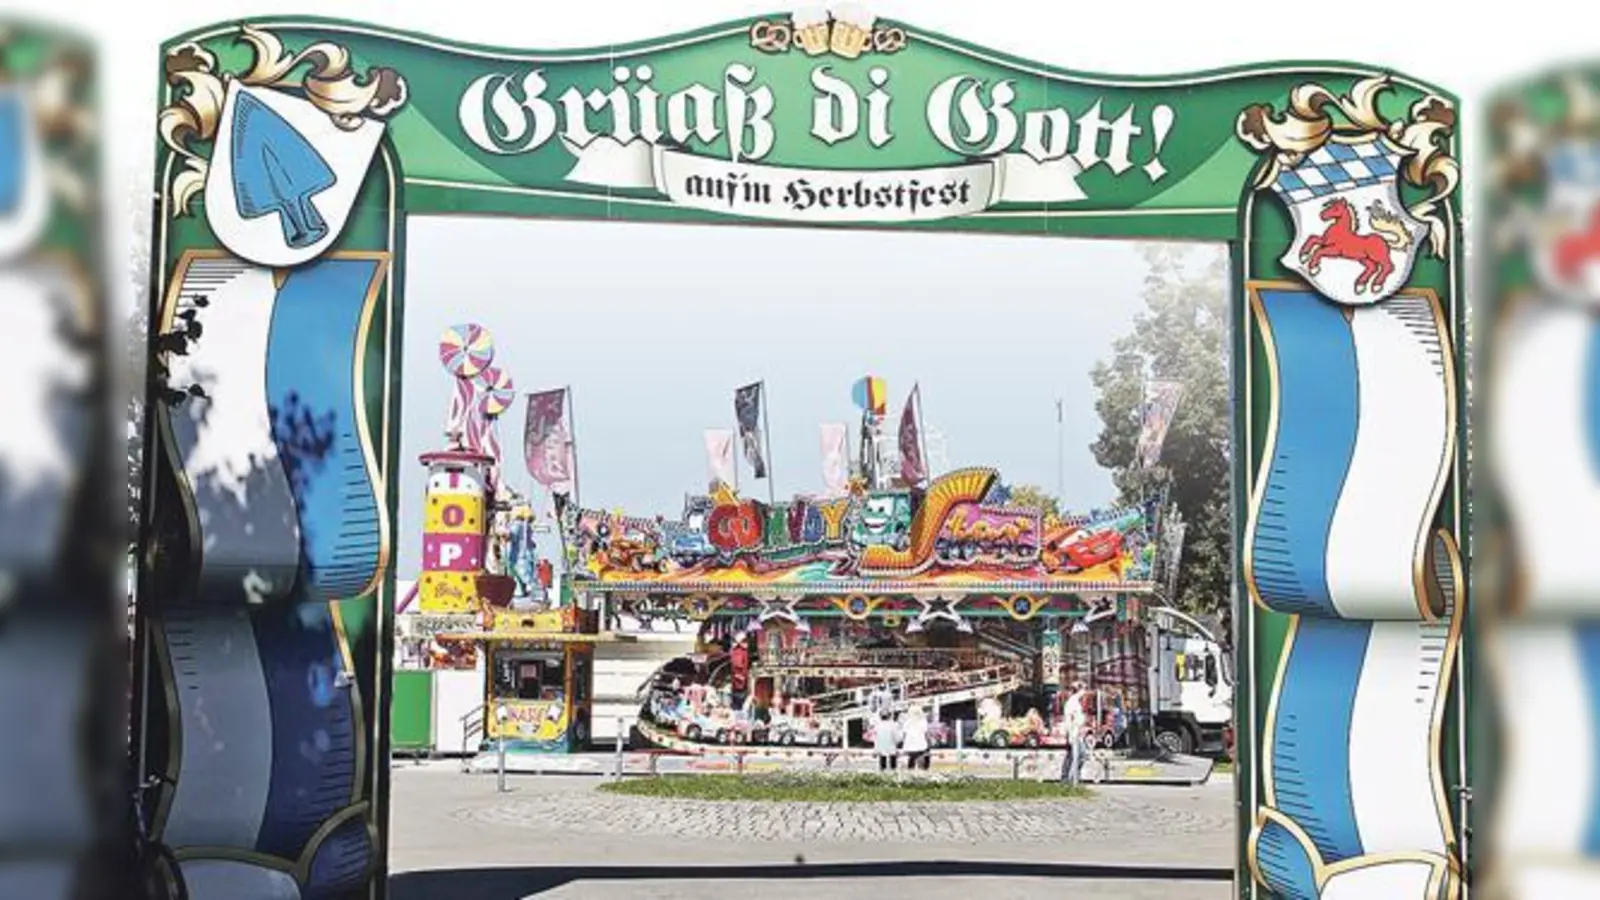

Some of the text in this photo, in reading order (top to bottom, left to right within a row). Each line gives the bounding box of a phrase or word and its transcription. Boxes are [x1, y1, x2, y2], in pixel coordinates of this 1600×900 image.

[458, 63, 1175, 183] Grüaß di Gott!
[783, 178, 970, 214] Herbstfest
